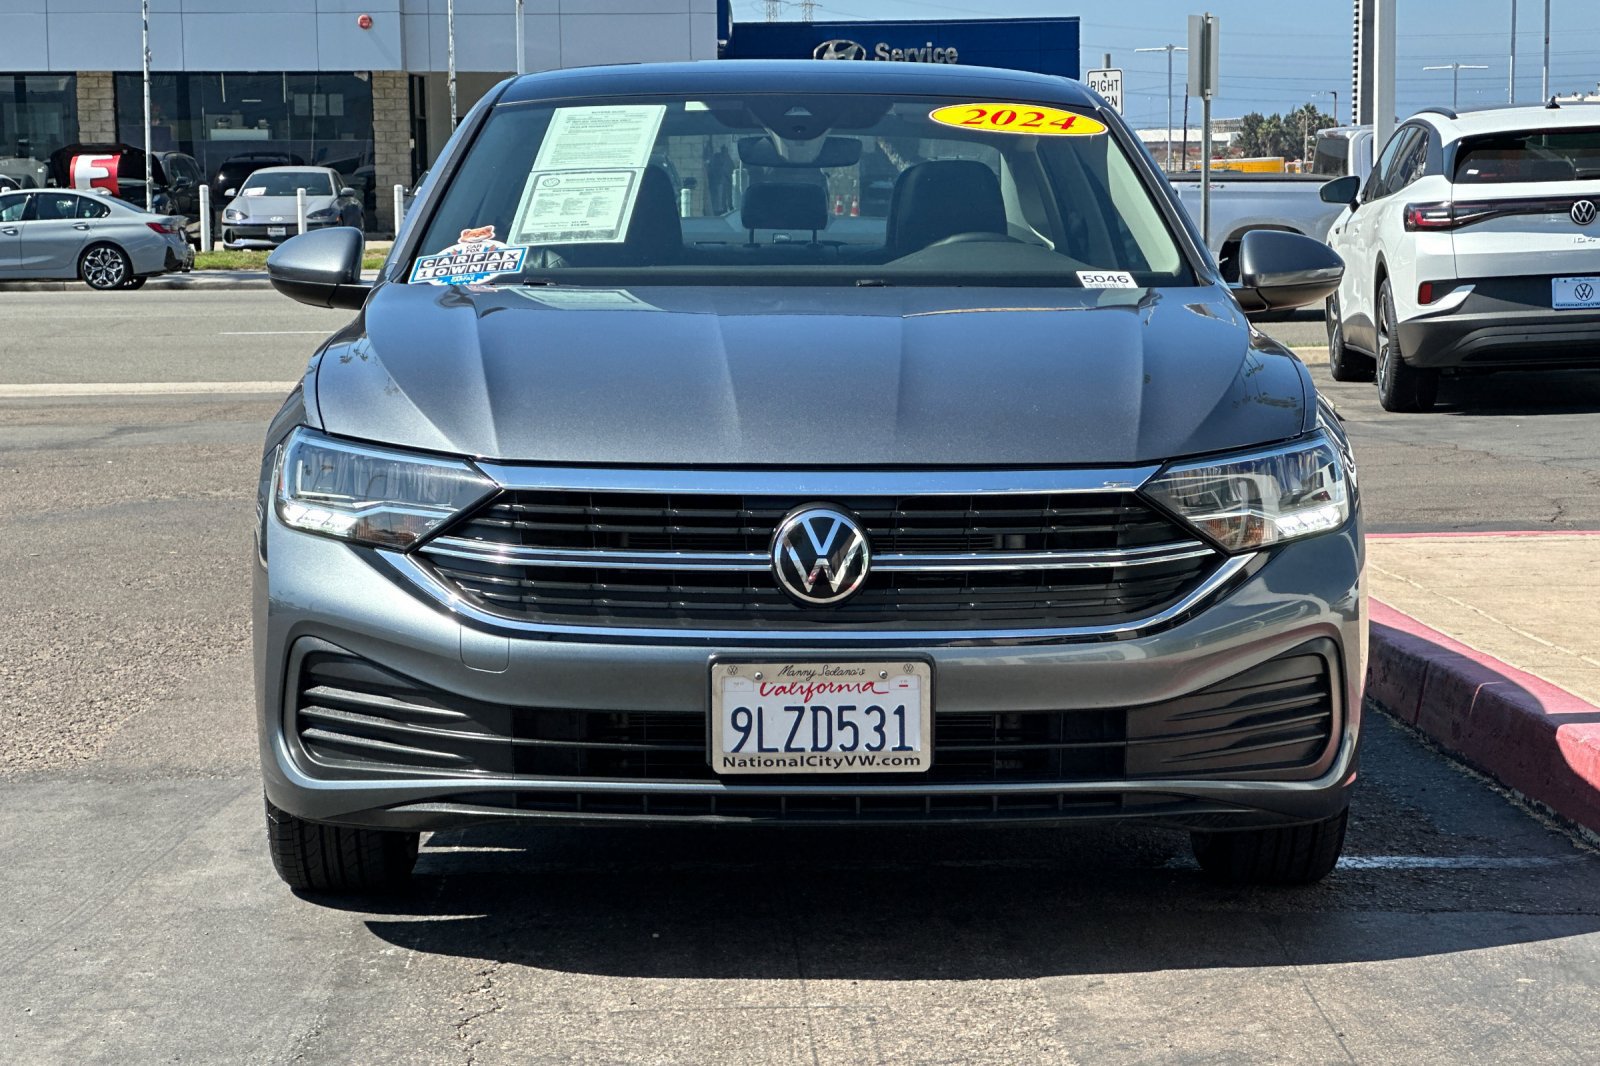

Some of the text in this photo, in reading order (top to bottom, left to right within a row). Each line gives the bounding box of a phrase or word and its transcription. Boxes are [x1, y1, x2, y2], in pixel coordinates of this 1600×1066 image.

[874, 41, 959, 64] Service
[1090, 79, 1120, 92] RIGHT
[959, 108, 1077, 130] 2024
[422, 252, 519, 268] CARFAX
[421, 261, 515, 278] 1 OWNER
[1082, 275, 1129, 283] 5046
[774, 508, 869, 604] VW
[777, 664, 817, 681] Manny
[759, 681, 889, 703] California
[730, 704, 914, 753] 9LZD531
[723, 755, 921, 769] NationalCityVW.com
